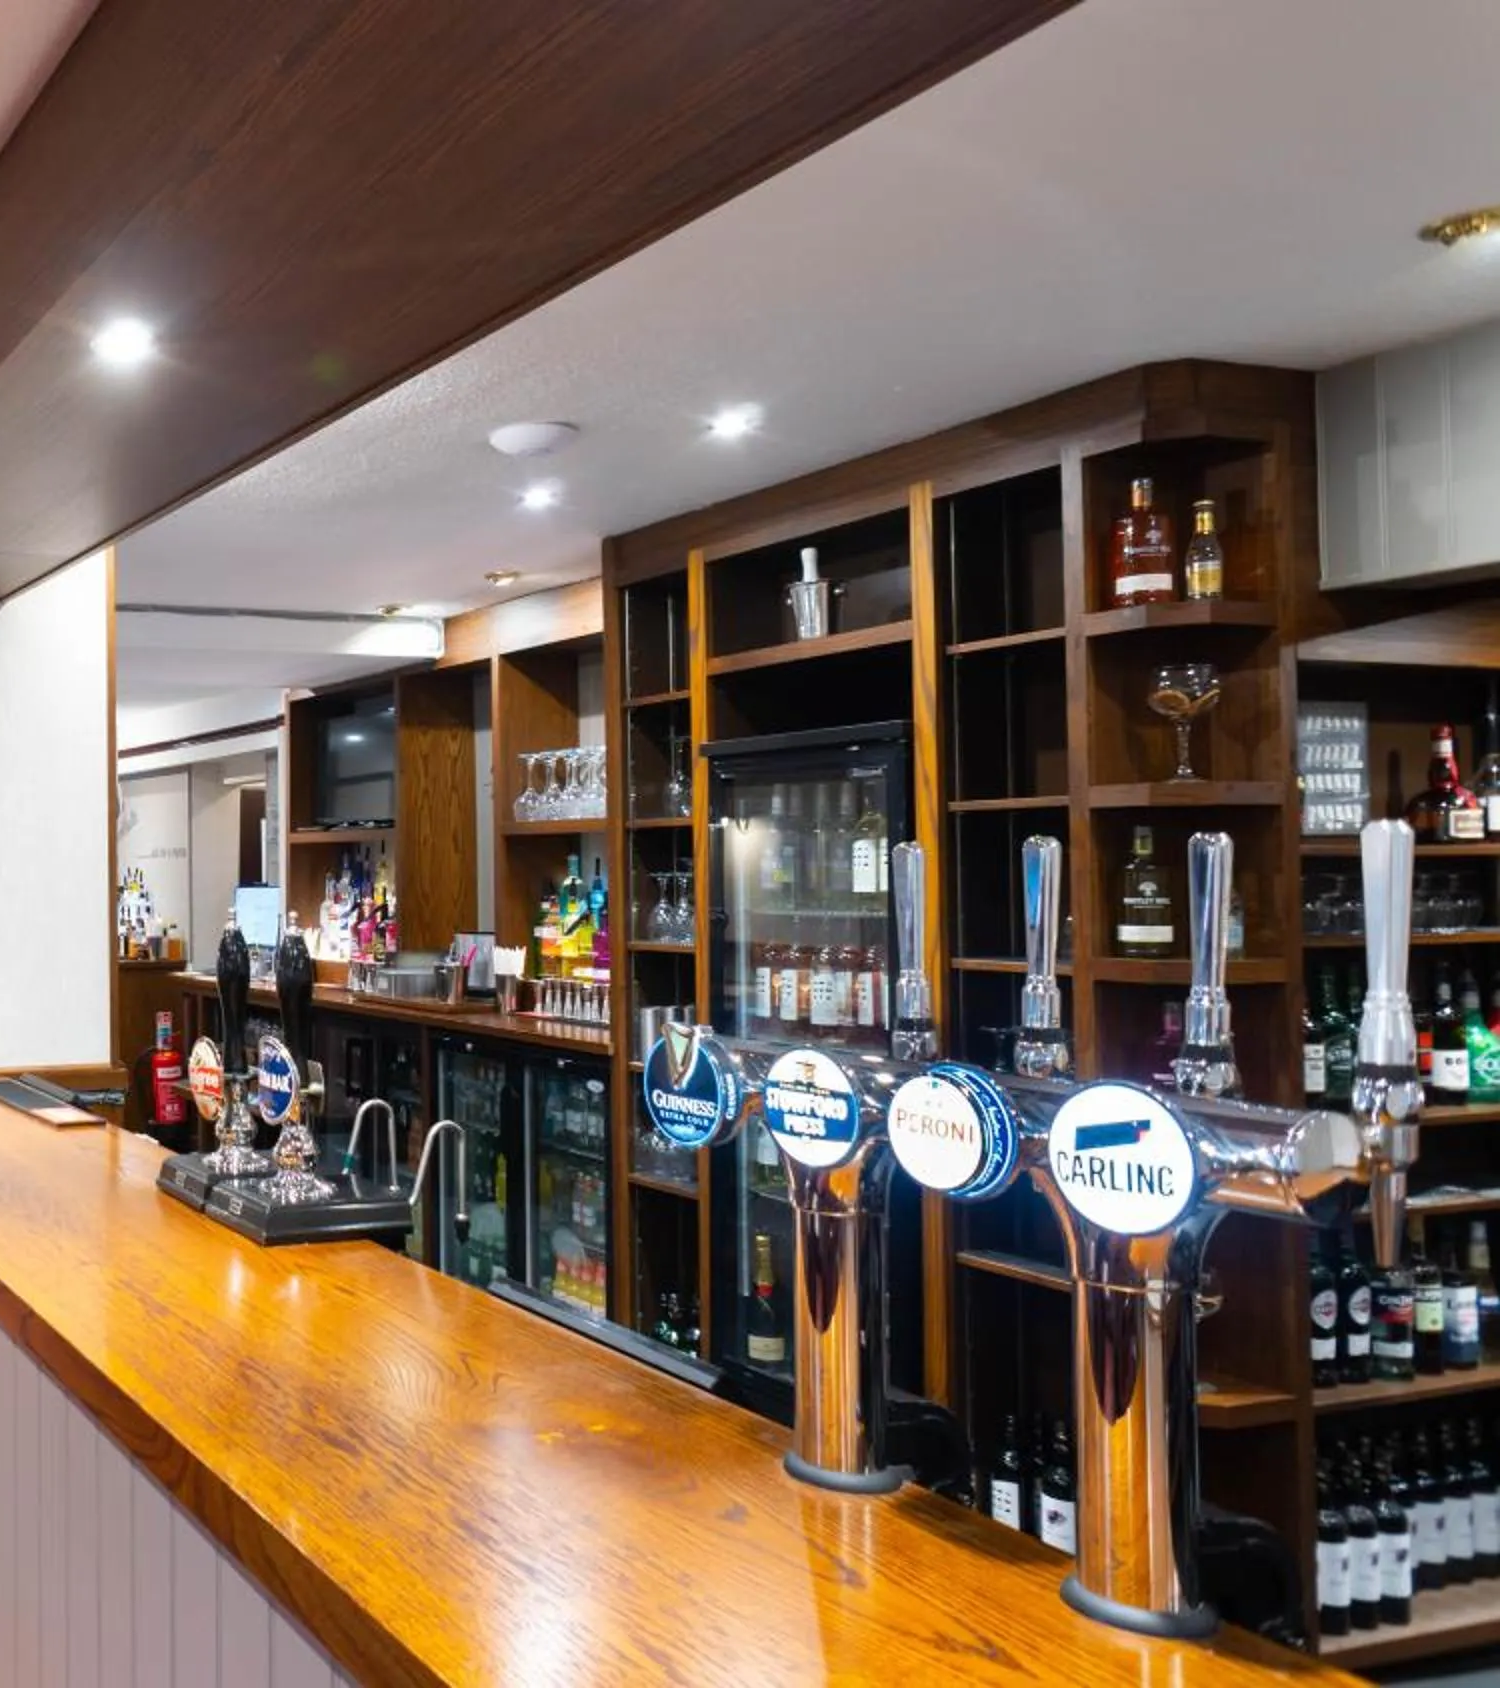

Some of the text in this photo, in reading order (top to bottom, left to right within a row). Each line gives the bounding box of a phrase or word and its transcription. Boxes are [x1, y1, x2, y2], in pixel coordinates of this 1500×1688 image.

[651, 1088, 717, 1119] GUINNESS
[659, 1109, 686, 1122] EXTRA
[896, 1107, 975, 1145] PERONI
[1056, 1150, 1175, 1197] CARLING
